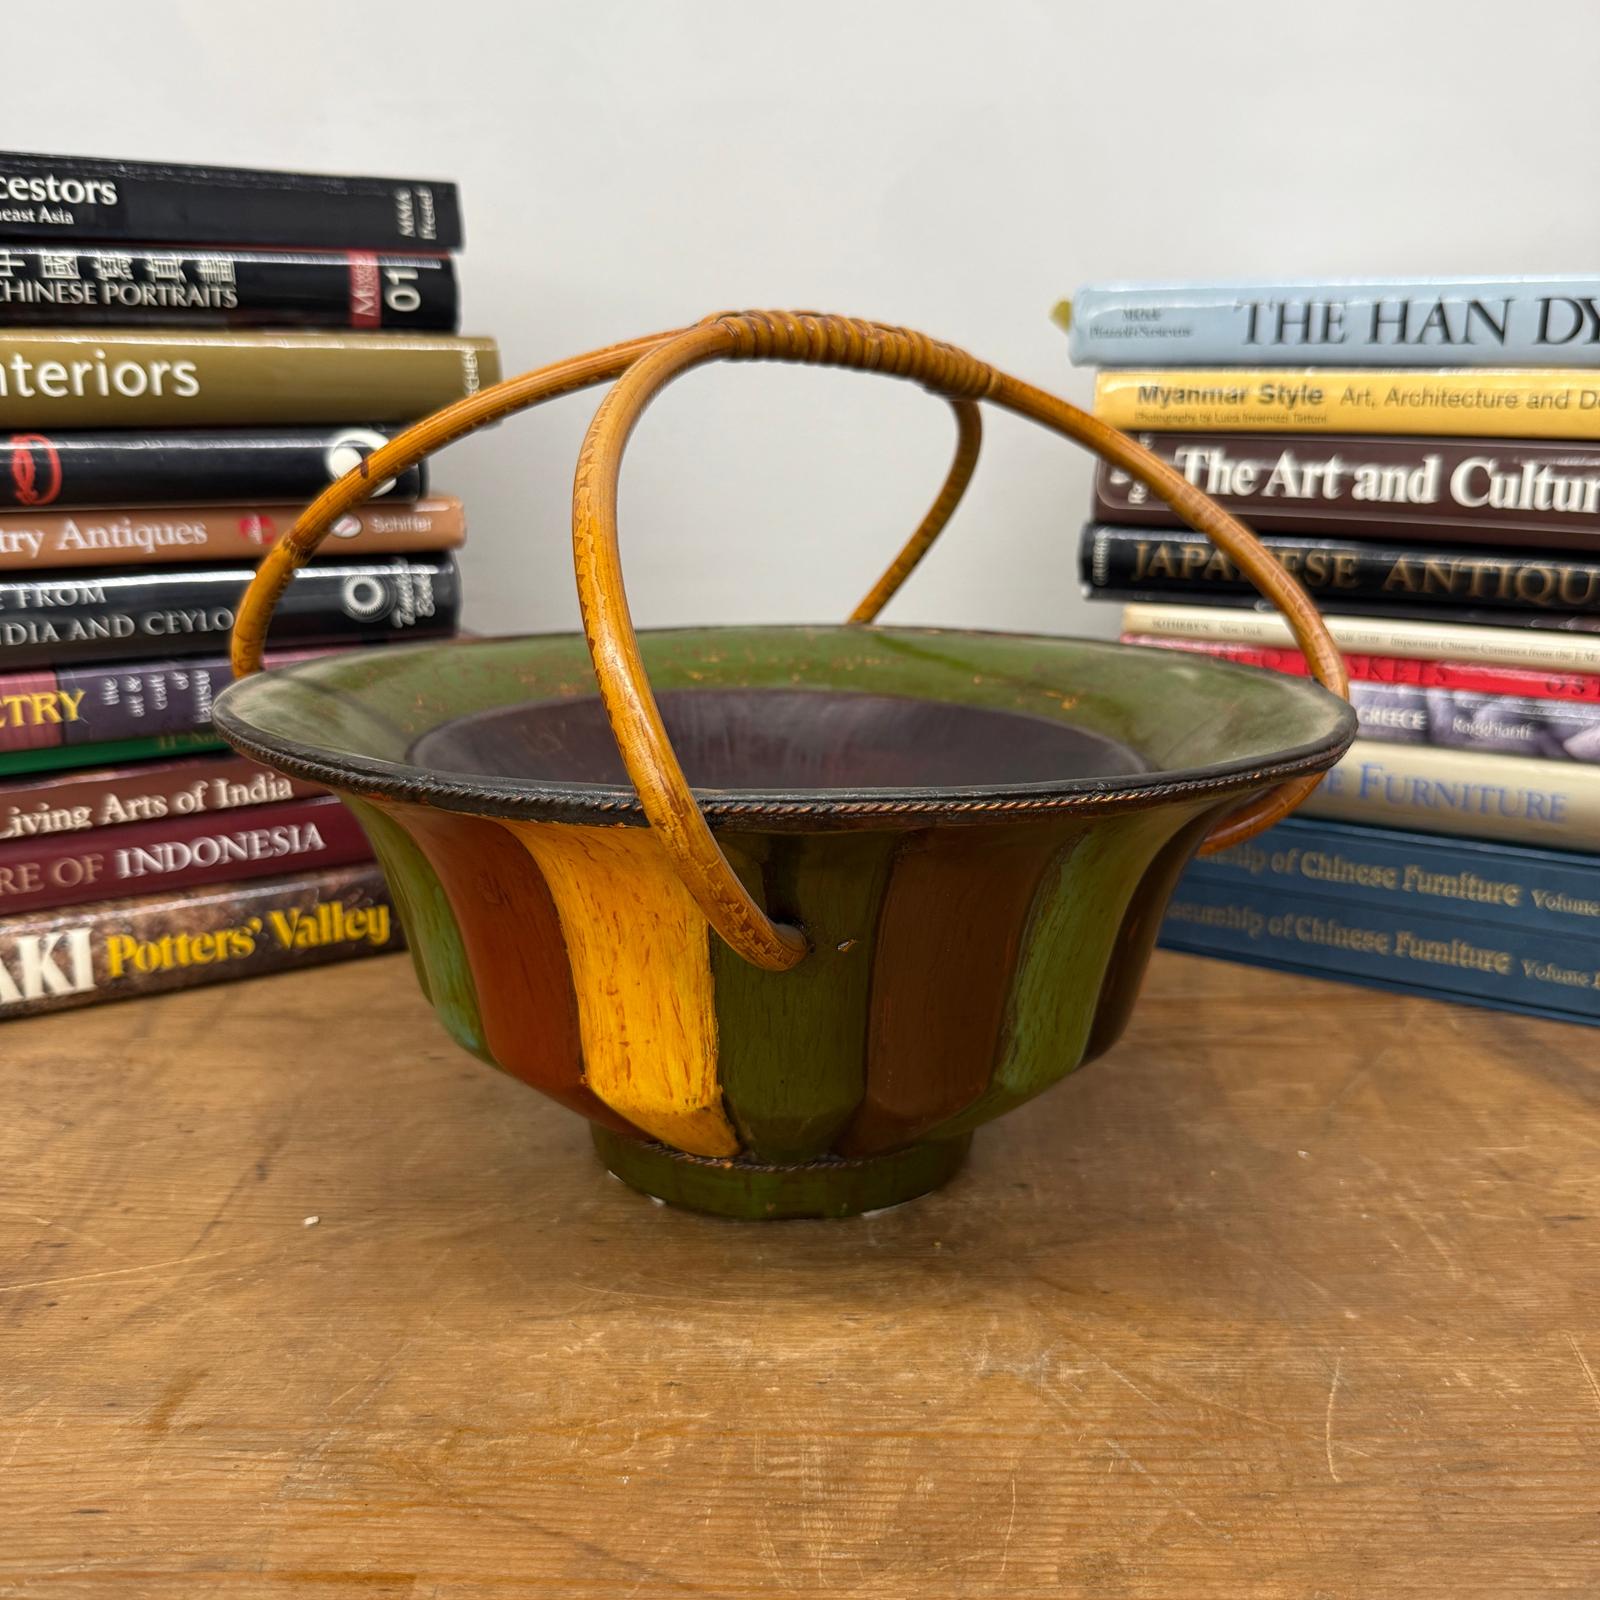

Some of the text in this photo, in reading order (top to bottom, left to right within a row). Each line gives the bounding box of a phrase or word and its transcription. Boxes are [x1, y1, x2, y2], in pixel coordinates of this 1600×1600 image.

[0, 204, 75, 225] east Asia
[101, 281, 238, 308] PORTRAITS
[1233, 298, 1350, 346] THE
[1367, 298, 1516, 347] HAN
[1138, 383, 1600, 412] Myanmar Style Art, Architecture and D
[1174, 446, 1258, 499] The
[1264, 450, 1344, 500] Art
[1350, 455, 1444, 506] and
[56, 516, 208, 552] Antiques
[1132, 541, 1362, 589] JAPAESE
[16, 586, 108, 609] FROM
[0, 606, 236, 647] DIA AND CEYLO
[0, 688, 86, 728] TRY
[1358, 706, 1428, 731] GREECE
[97, 792, 169, 825] Arts
[167, 779, 209, 813] of
[210, 770, 294, 808] India
[1359, 762, 1569, 823] FURNITURE
[52, 853, 104, 888] OF
[114, 822, 326, 879] INDONESIA
[1270, 848, 1299, 875] of
[1301, 850, 1396, 892] Chinese
[1402, 863, 1522, 908] Furniture
[106, 916, 262, 978] Potters'
[270, 901, 391, 950] Valley
[1268, 913, 1296, 938] of
[1295, 914, 1390, 955] Chinese
[1393, 929, 1512, 976] Furniture
[1521, 959, 1589, 989] Volume
